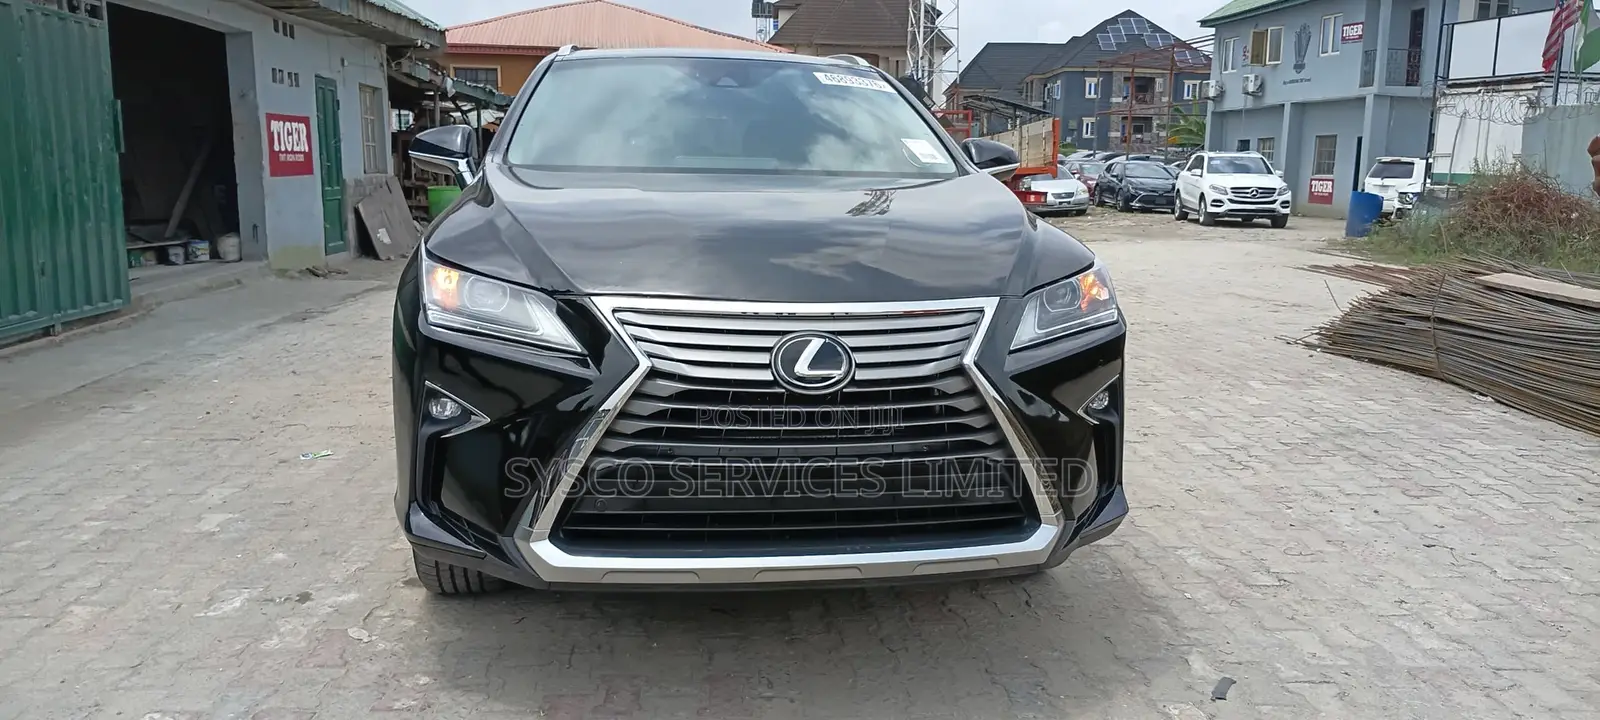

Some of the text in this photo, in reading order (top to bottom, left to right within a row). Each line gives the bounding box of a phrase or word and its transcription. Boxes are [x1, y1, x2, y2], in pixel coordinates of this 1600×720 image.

[1342, 24, 1363, 36] TIGER
[270, 120, 309, 152] TIGER
[1311, 180, 1333, 193] TIGER
